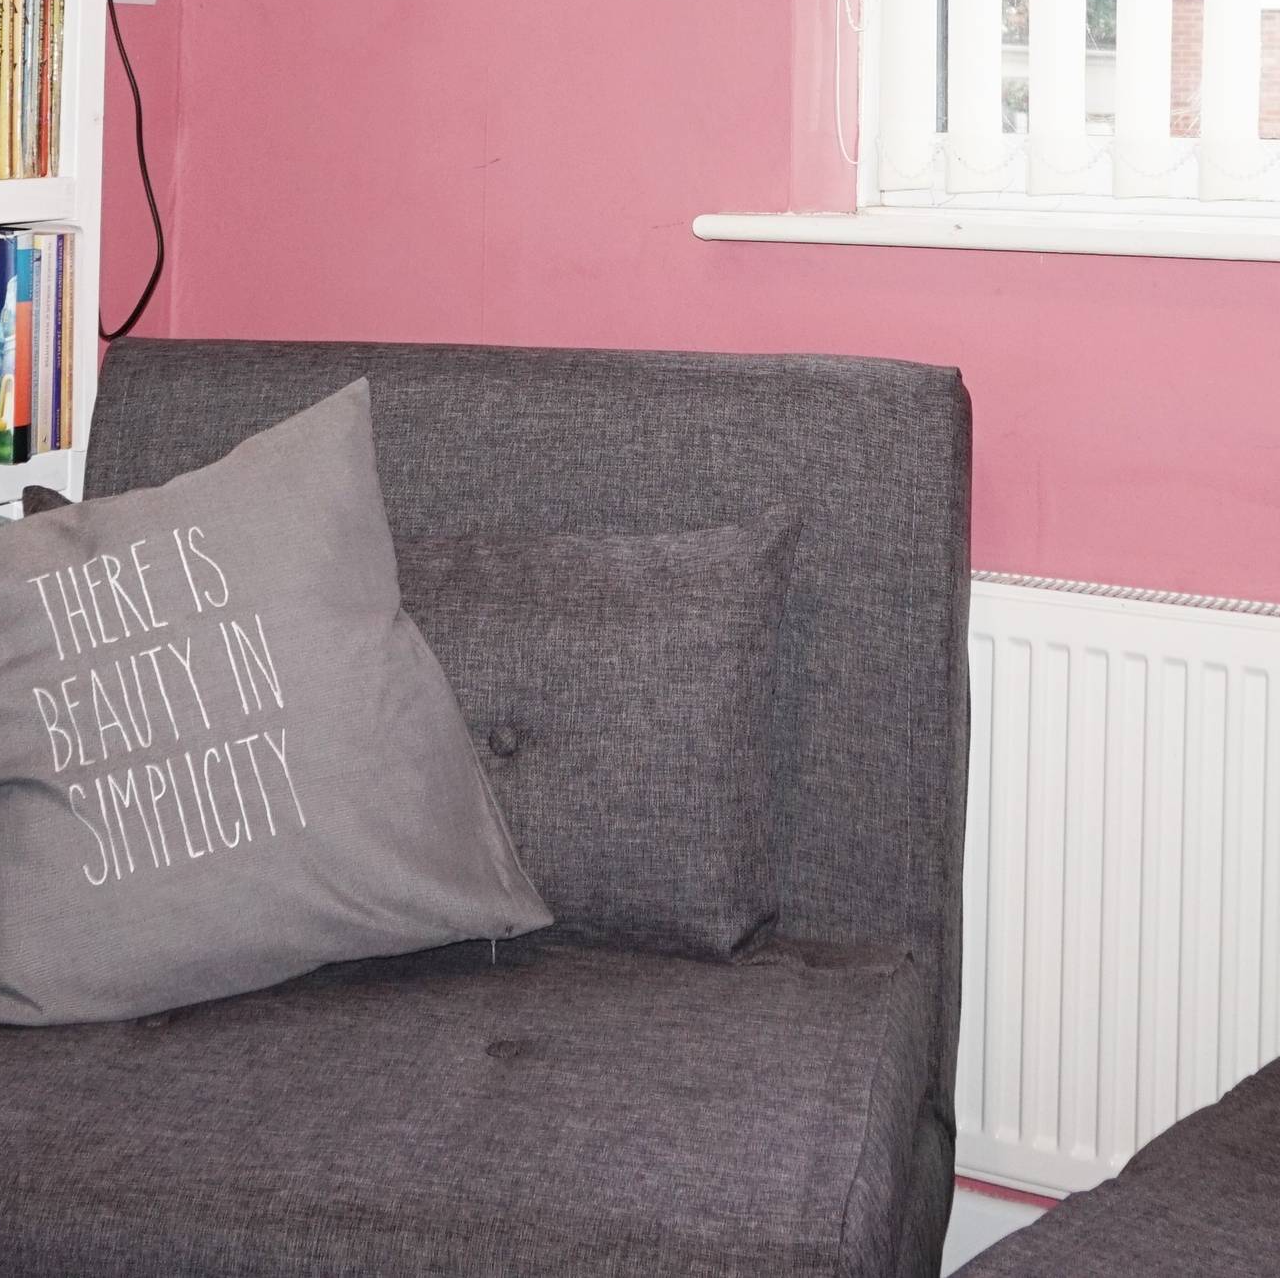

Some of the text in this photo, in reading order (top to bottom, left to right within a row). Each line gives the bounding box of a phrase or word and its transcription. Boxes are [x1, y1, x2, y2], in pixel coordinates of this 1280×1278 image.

[27, 526, 229, 660] THERE IS
[33, 613, 285, 773] BEAUTY IN
[68, 727, 306, 885] SIMPLICITY
